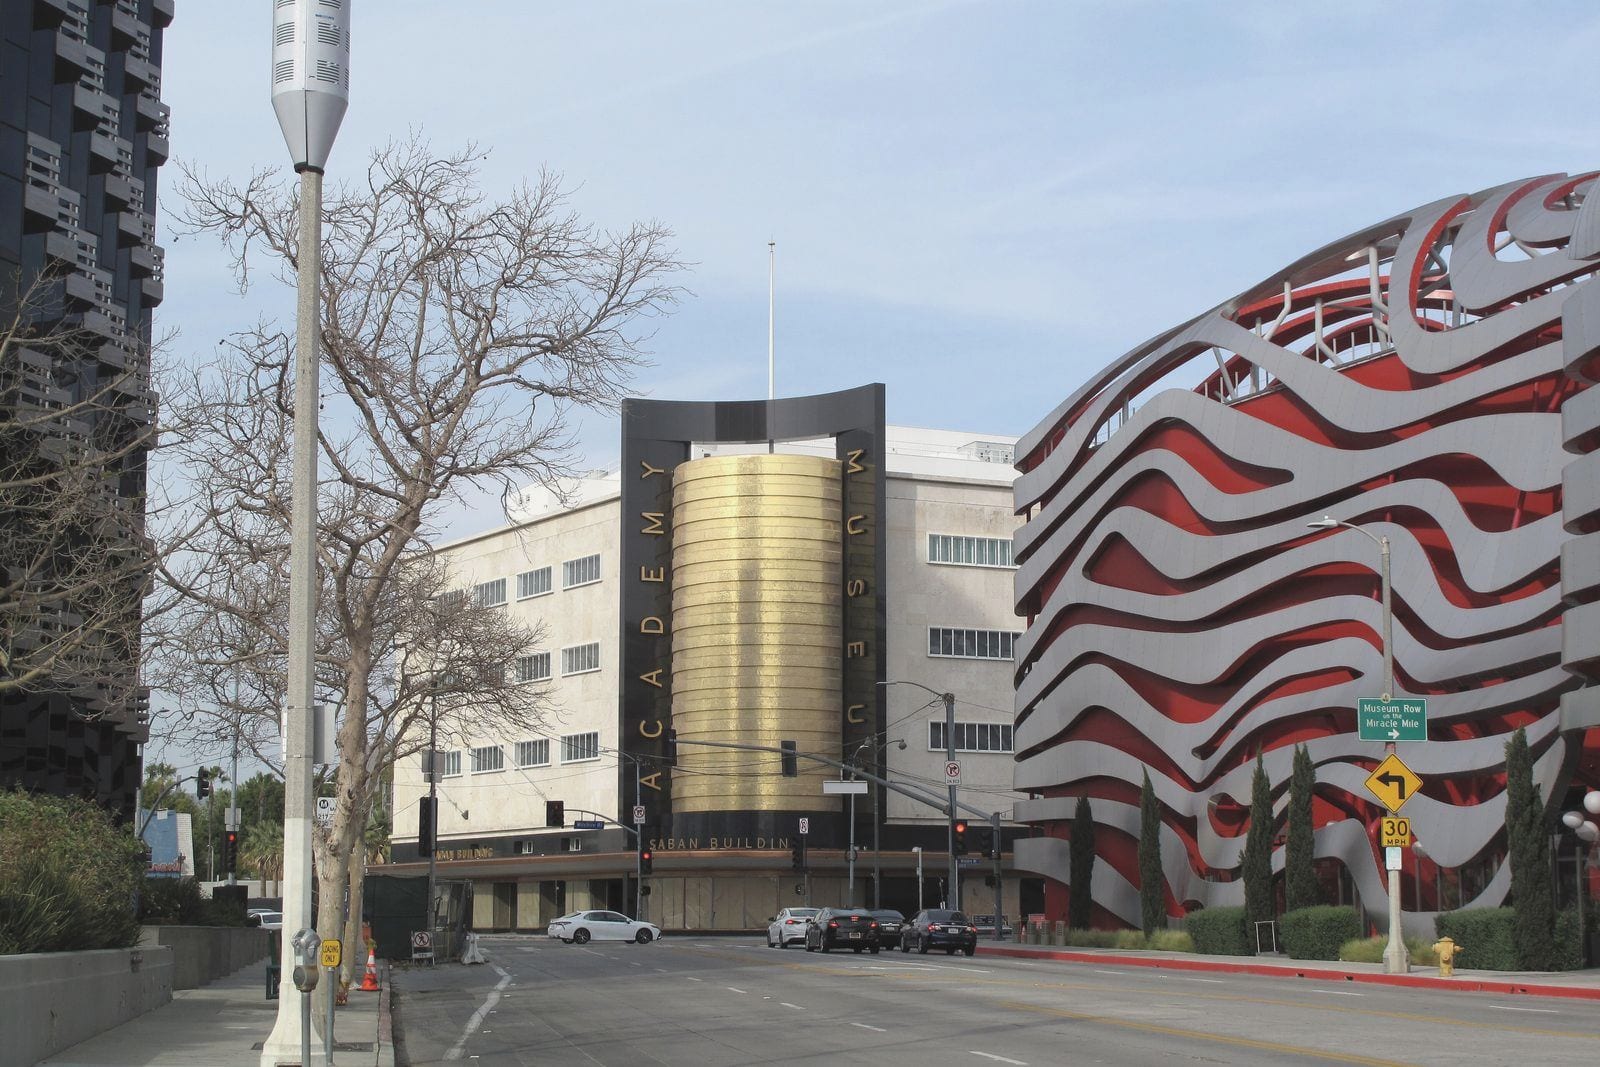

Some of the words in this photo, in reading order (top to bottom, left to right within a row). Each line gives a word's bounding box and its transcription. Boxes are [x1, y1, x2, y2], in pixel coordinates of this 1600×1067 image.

[846, 449, 867, 724] MUSEU
[640, 460, 665, 791] ACADEMY
[1364, 704, 1399, 713] Museum
[1403, 704, 1421, 713] Row
[1366, 719, 1398, 728] Miracle
[1402, 719, 1419, 728] Mile
[1385, 820, 1408, 837] 30
[649, 838, 698, 850] SABAN
[710, 837, 789, 850] BUILDIN
